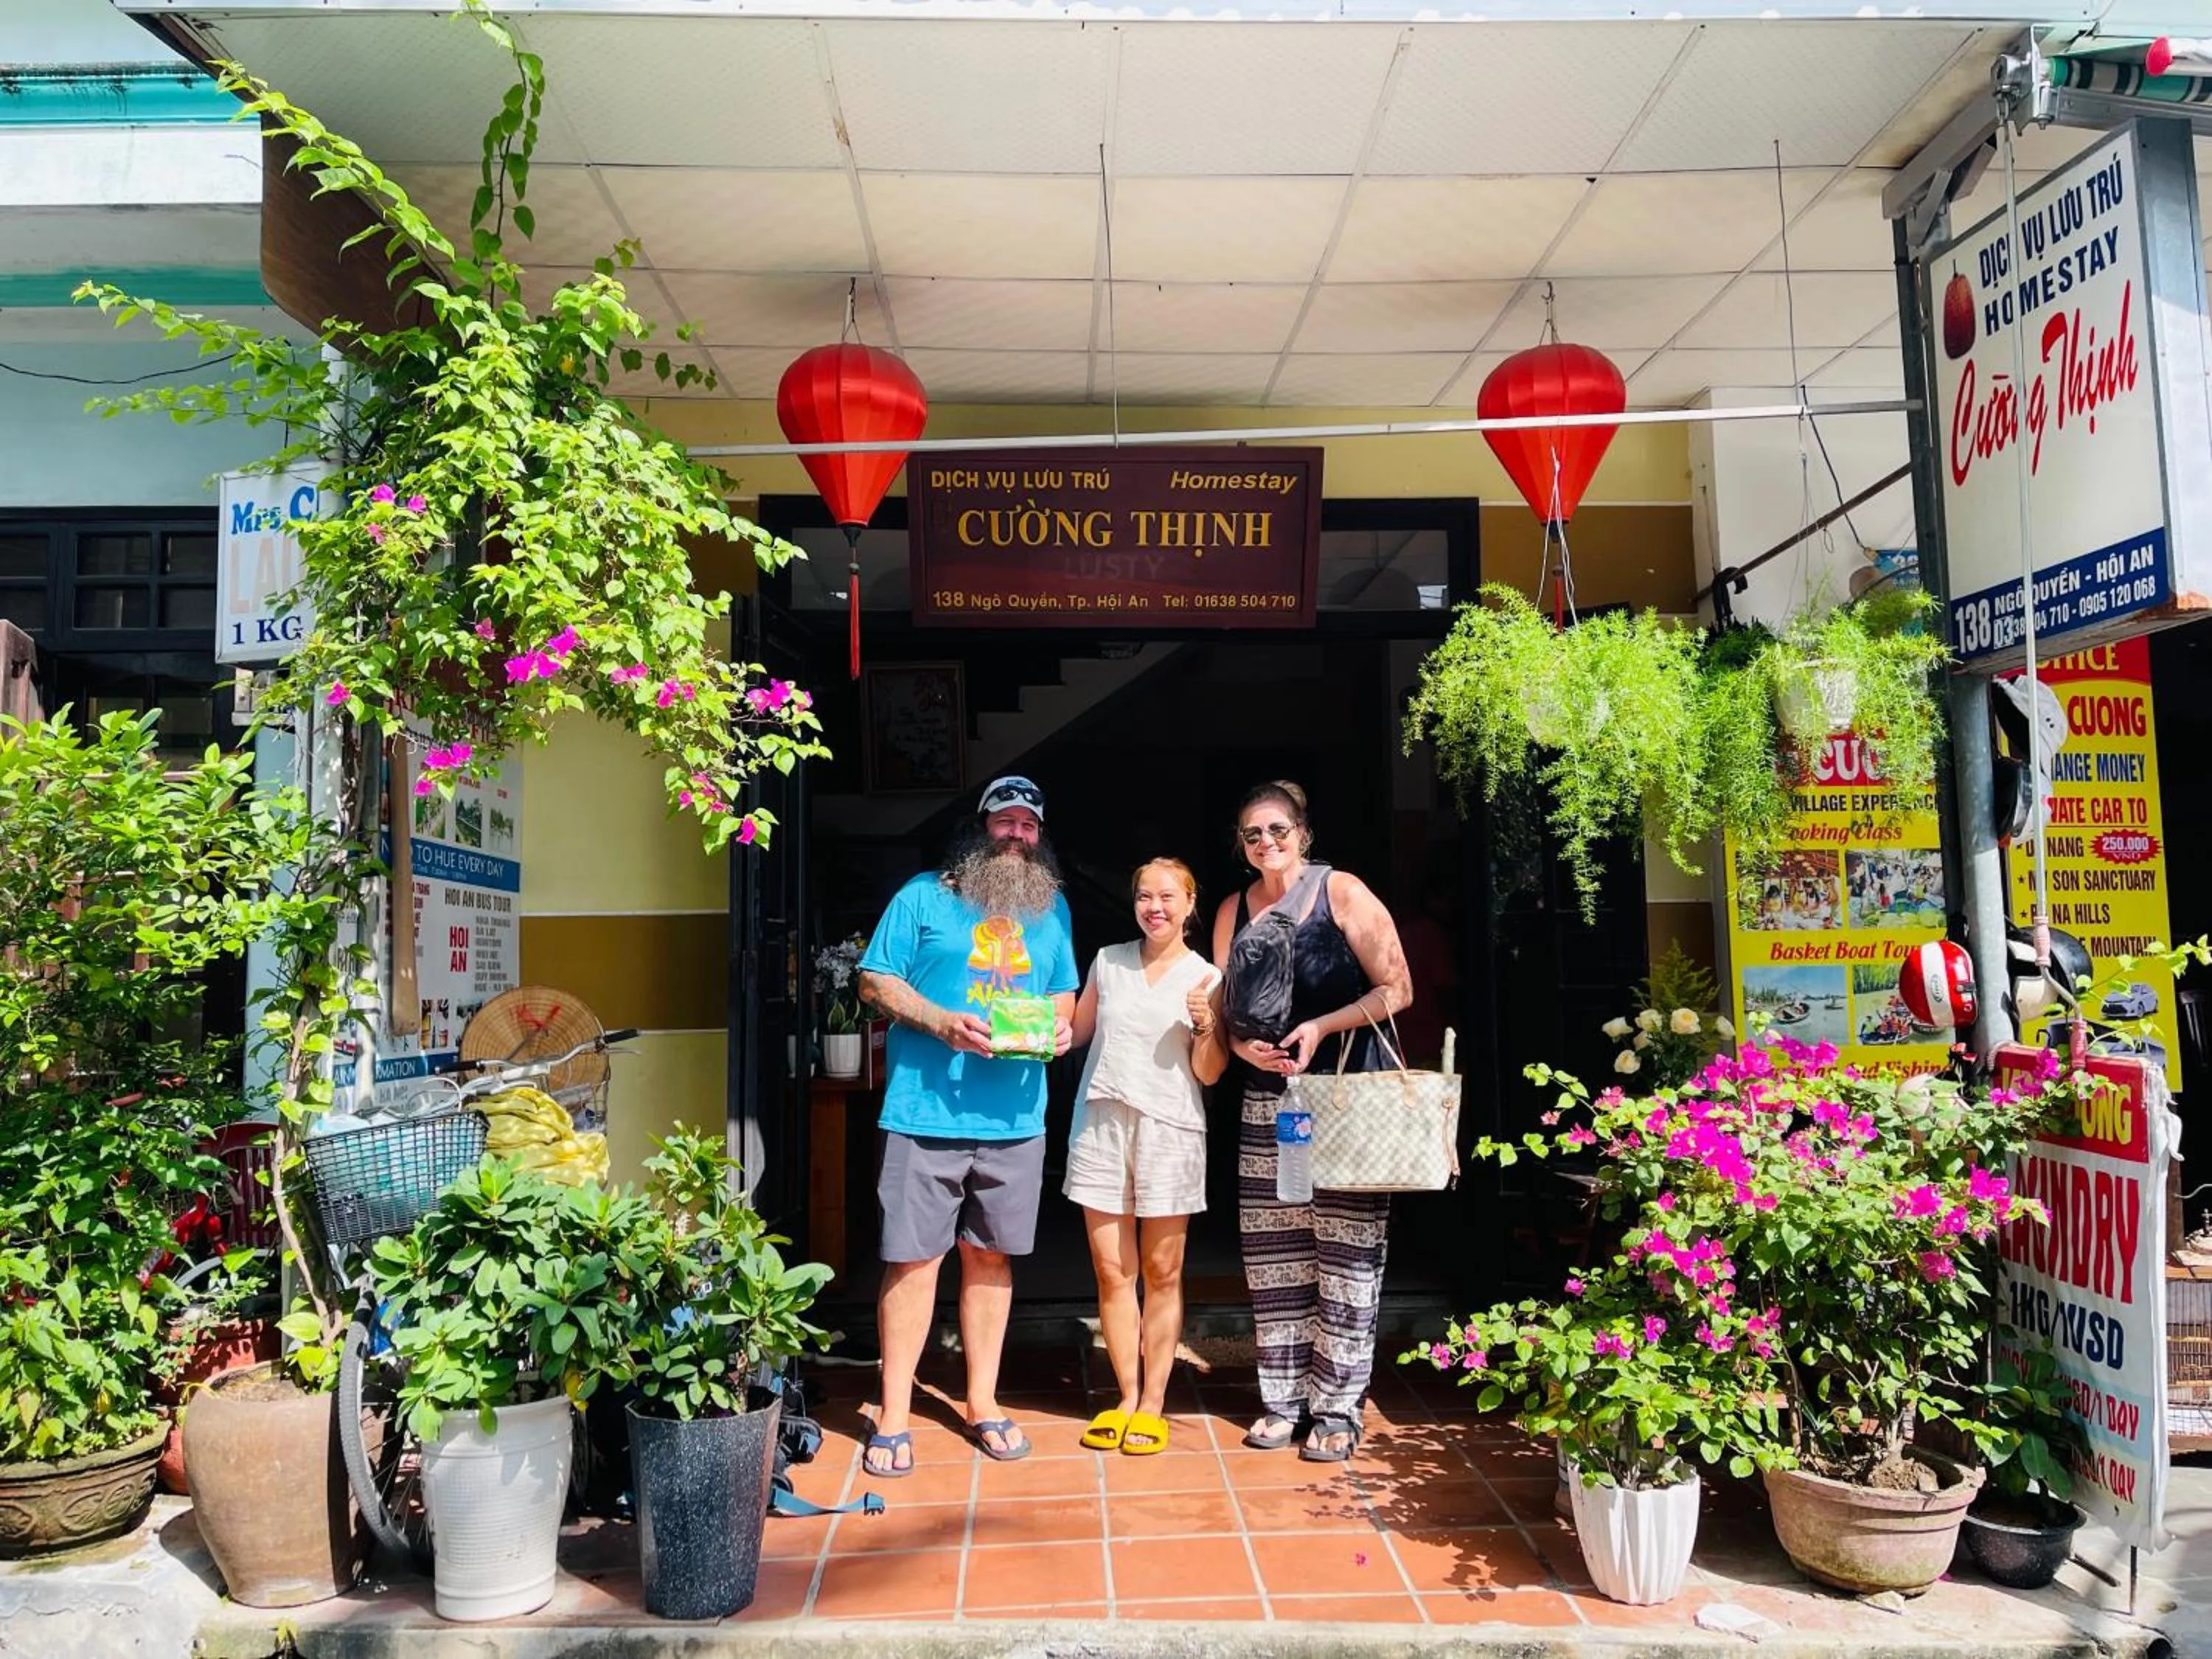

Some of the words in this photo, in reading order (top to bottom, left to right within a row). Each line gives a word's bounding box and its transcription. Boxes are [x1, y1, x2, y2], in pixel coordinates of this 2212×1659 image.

[2021, 211, 2045, 260] VỤ
[2048, 188, 2083, 244] LƯU
[2087, 152, 2124, 219] TRÚ
[1984, 225, 2118, 336] HOMESTAY
[2042, 279, 2138, 434] Thịnh
[931, 470, 978, 493] DỊCH
[987, 470, 1015, 493] VỤ
[1023, 468, 1062, 489] LƯU
[1071, 467, 1110, 490] TRÚ
[1170, 471, 1298, 494] Homestay
[231, 501, 281, 535] Mrs
[959, 498, 1113, 547] CƯỜNG
[1130, 511, 1273, 557] THỊNH
[933, 591, 964, 607] 138
[971, 593, 1001, 611] Ngô
[1068, 594, 1091, 610] Tp.
[1097, 594, 1121, 611] Hội
[1128, 594, 1149, 608] An
[1194, 594, 1237, 608] 01638
[1241, 594, 1267, 608] 504
[1272, 594, 1295, 608] 710
[1955, 598, 1991, 654] 138
[2096, 553, 2124, 583] HỘI
[2129, 544, 2154, 571] AN
[2050, 602, 2070, 627] 710
[2079, 591, 2107, 617] 0905
[2110, 583, 2131, 608] 120
[2134, 575, 2156, 602] 068
[232, 622, 245, 645] 1
[256, 616, 303, 643] KG
[2067, 695, 2147, 737] CUONG
[2096, 753, 2145, 782] MONEY
[1792, 794, 1847, 812] VILLAGE
[2091, 797, 2124, 824] CAR
[2127, 797, 2148, 824] TO
[1791, 821, 1849, 845] ooking
[2047, 837, 2084, 858] NANG
[2102, 836, 2149, 850] 250.000
[2113, 852, 2141, 860] VND
[415, 844, 433, 863] TO
[434, 849, 456, 869] HUE
[458, 854, 487, 874] EVERY
[487, 860, 505, 878] DAY
[2052, 870, 2080, 891] SON
[2083, 870, 2156, 891] SANCTUARY
[445, 887, 461, 906] HOI
[462, 889, 475, 908] AN
[476, 891, 492, 911] BUS
[493, 894, 512, 913] TOUR
[2052, 904, 2071, 925] NA
[2075, 903, 2110, 925] HILLS
[449, 926, 469, 949] HOI
[1770, 942, 1832, 960] Basket
[1835, 940, 1877, 959] Boat
[450, 950, 467, 973] AN
[2106, 1394, 2139, 1441] DAY
[2109, 1458, 2136, 1505] DAY
